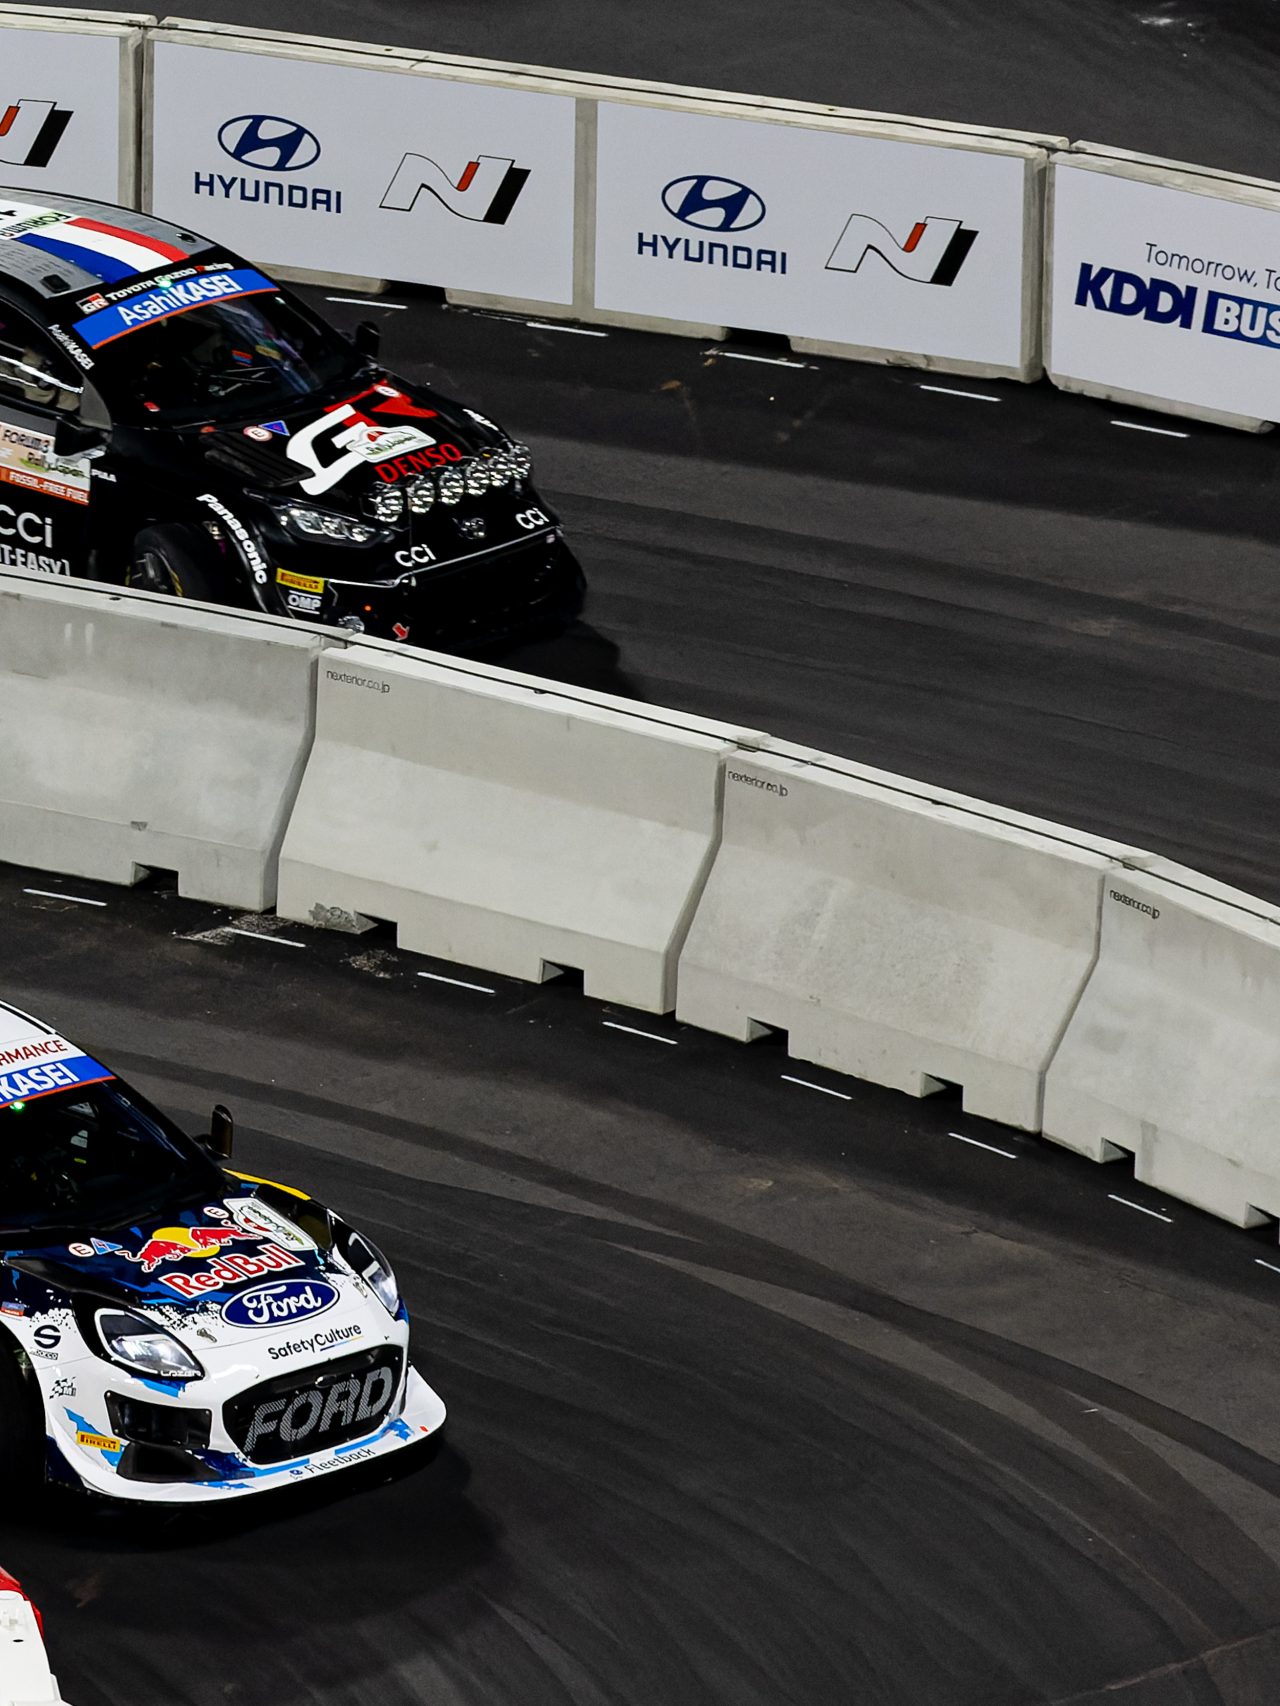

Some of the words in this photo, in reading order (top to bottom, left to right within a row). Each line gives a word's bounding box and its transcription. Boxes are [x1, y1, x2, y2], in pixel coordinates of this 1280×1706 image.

[194, 172, 341, 213] HYUNDAI
[637, 232, 787, 274] HYUNDAI
[1145, 242, 1259, 287] Tomorrow,
[105, 280, 155, 301] TOYOTA
[1074, 262, 1199, 329] KDDI
[374, 443, 462, 484] DENSO
[196, 494, 268, 584] Panasonic
[242, 1284, 322, 1324] Ford
[268, 1324, 362, 1360] SafetyCulture
[243, 1366, 393, 1453] FORD
[80, 1434, 118, 1450] PIRELLI
[305, 1448, 376, 1474] Fleetback
